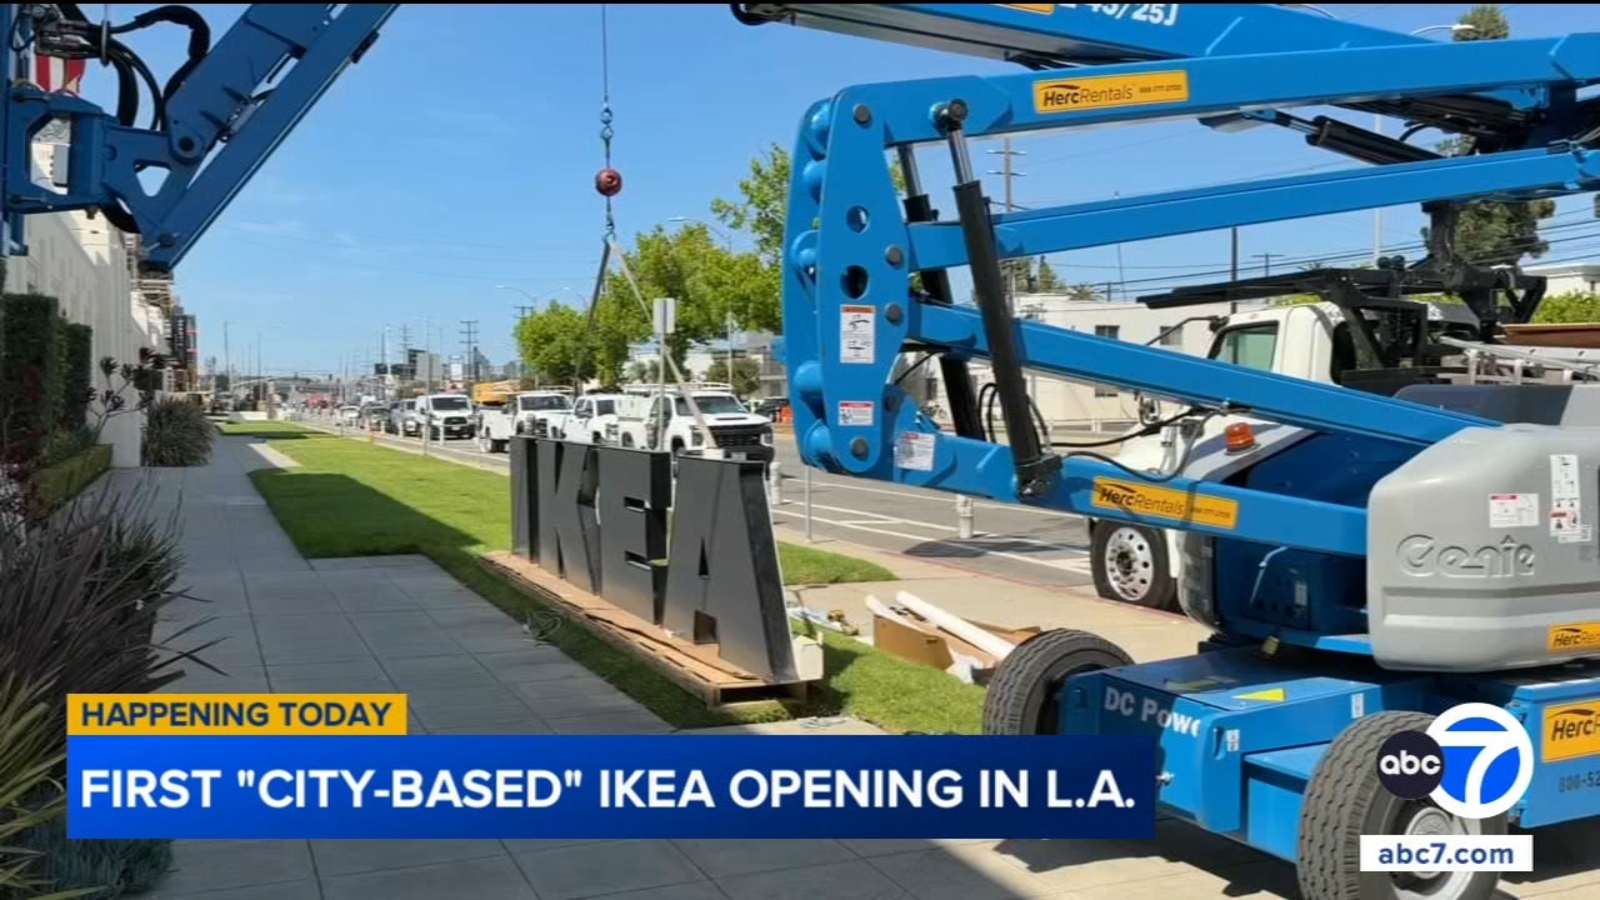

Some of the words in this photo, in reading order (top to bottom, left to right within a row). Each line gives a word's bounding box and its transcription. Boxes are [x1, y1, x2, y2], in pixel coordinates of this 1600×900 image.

[1042, 84, 1134, 107] HercRentals
[510, 436, 800, 684] IKEA
[1104, 686, 1134, 716] DC
